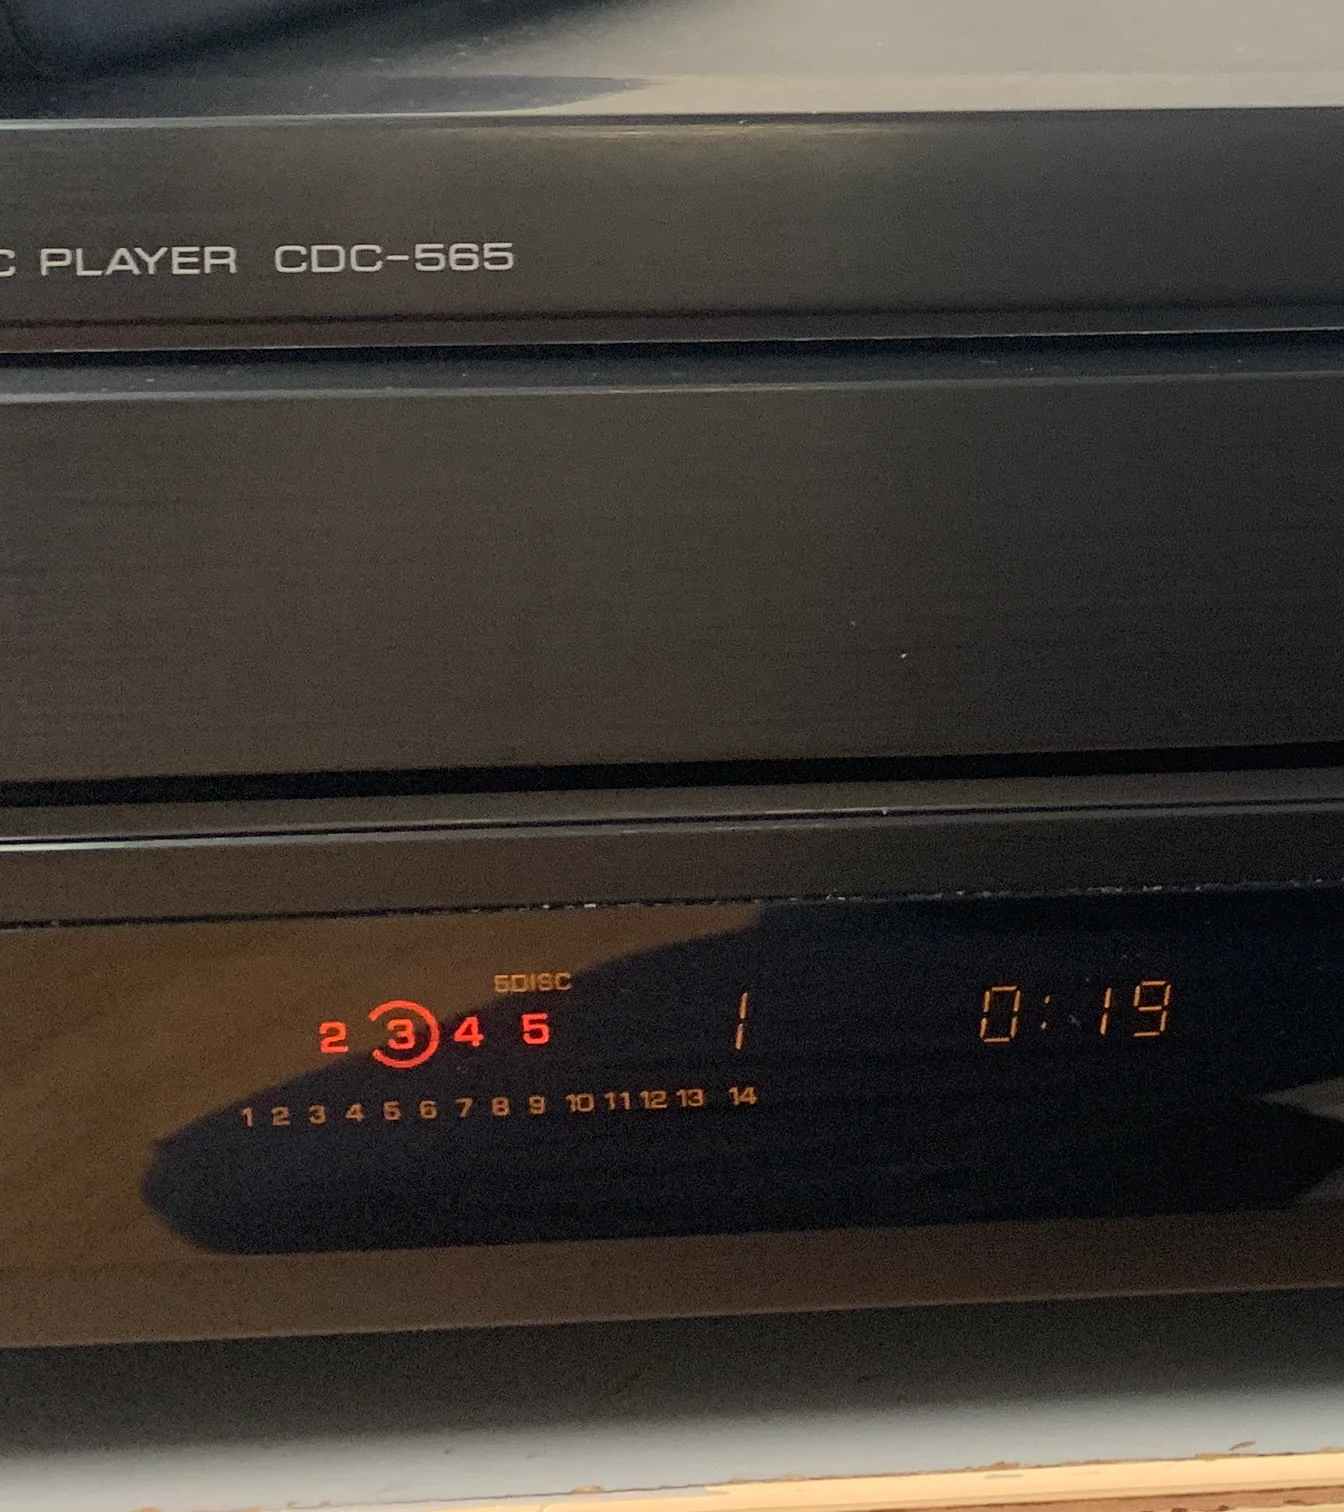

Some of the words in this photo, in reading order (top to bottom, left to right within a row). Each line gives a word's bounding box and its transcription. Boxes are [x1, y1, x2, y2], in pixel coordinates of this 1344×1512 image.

[40, 246, 237, 276] PLAYER
[274, 242, 515, 273] CDC-565
[979, 980, 1171, 1042] 0:19
[318, 1021, 349, 1054] 2
[386, 1018, 416, 1050] 3
[453, 1016, 484, 1047] 4
[521, 1012, 551, 1045] 5
[242, 1106, 254, 1127] 1
[271, 1105, 291, 1126] 2
[308, 1104, 327, 1124] 3
[345, 1102, 365, 1122] 4
[383, 1100, 401, 1121] 5
[419, 1100, 438, 1119] 6
[456, 1097, 474, 1118] 7
[491, 1096, 510, 1117] 8
[529, 1095, 547, 1115] 9
[566, 1092, 595, 1113] 10
[604, 1090, 631, 1111] 11
[640, 1089, 669, 1110] 12
[676, 1087, 705, 1108] 13
[728, 1085, 758, 1106] 14
